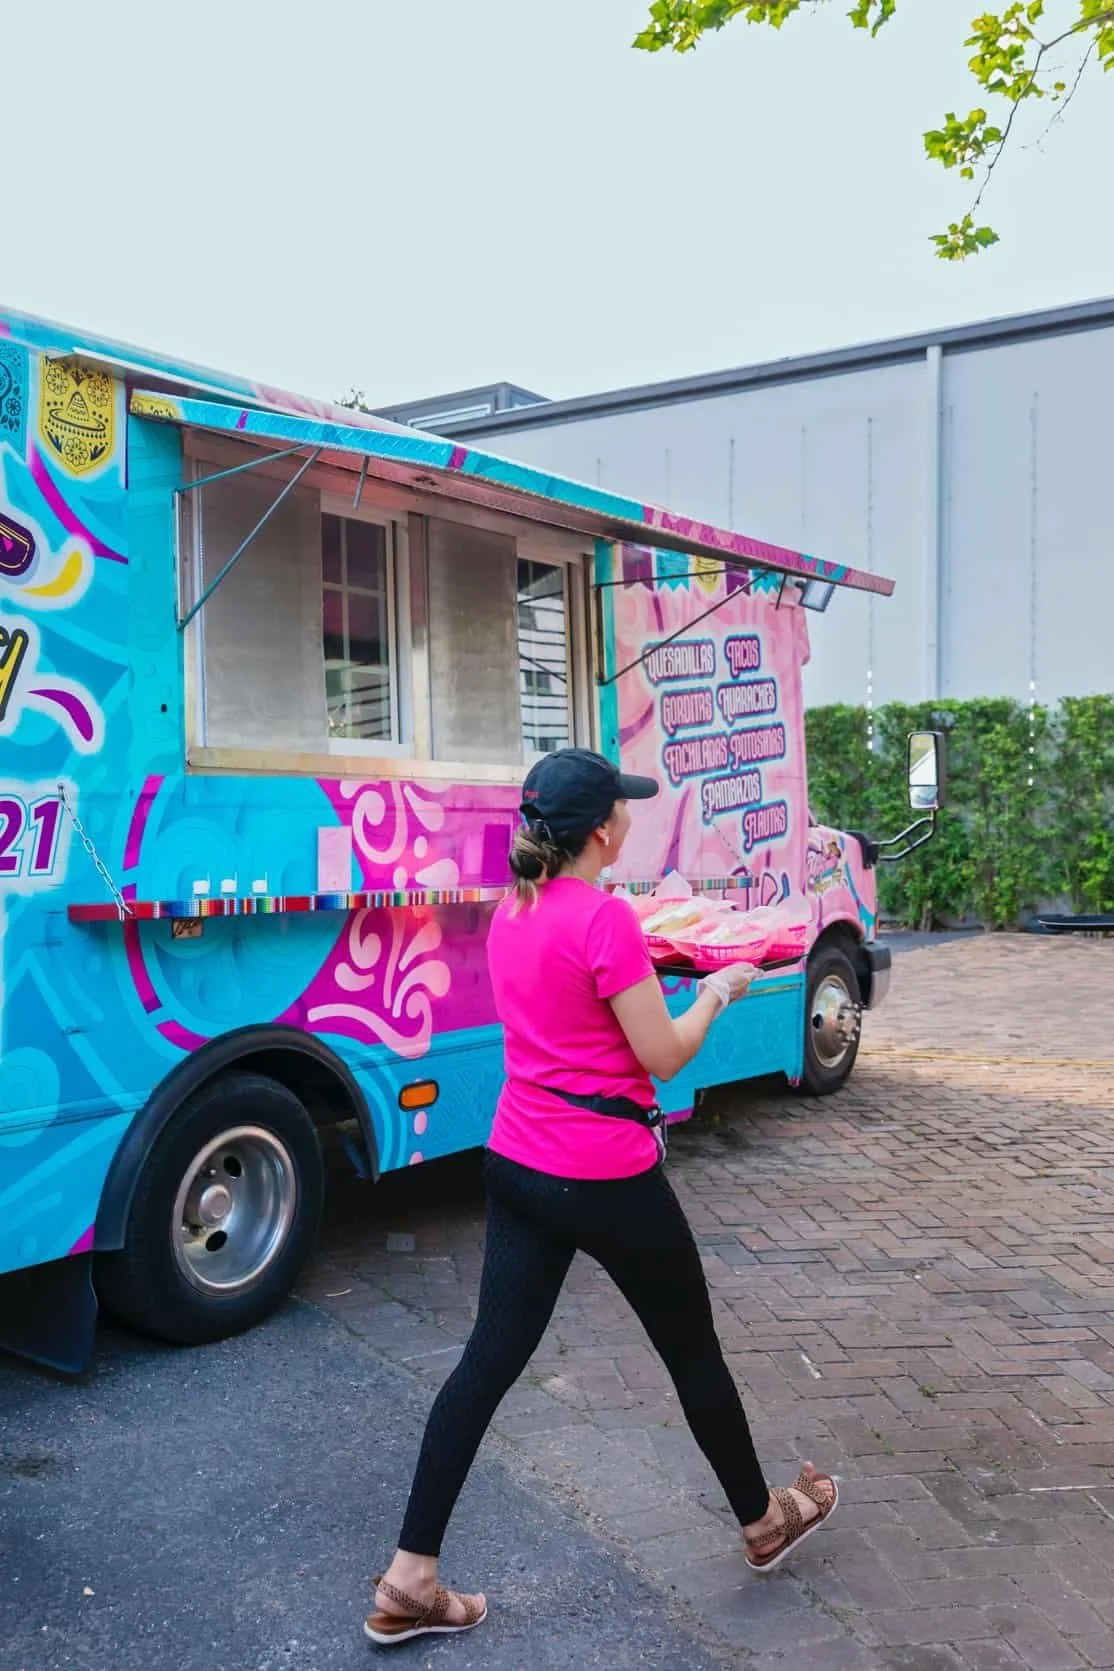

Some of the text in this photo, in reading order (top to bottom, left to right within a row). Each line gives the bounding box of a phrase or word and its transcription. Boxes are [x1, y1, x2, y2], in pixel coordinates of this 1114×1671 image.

[645, 644, 714, 680] QUESADILLAS
[727, 639, 759, 676] TACOS
[663, 692, 712, 734] GORDITAS
[719, 682, 775, 721] HUARACHES
[664, 727, 784, 782] ENCHILADAS POTOSINAS
[704, 773, 760, 820] PAMBAZOS
[744, 806, 786, 848] FLAUTAS
